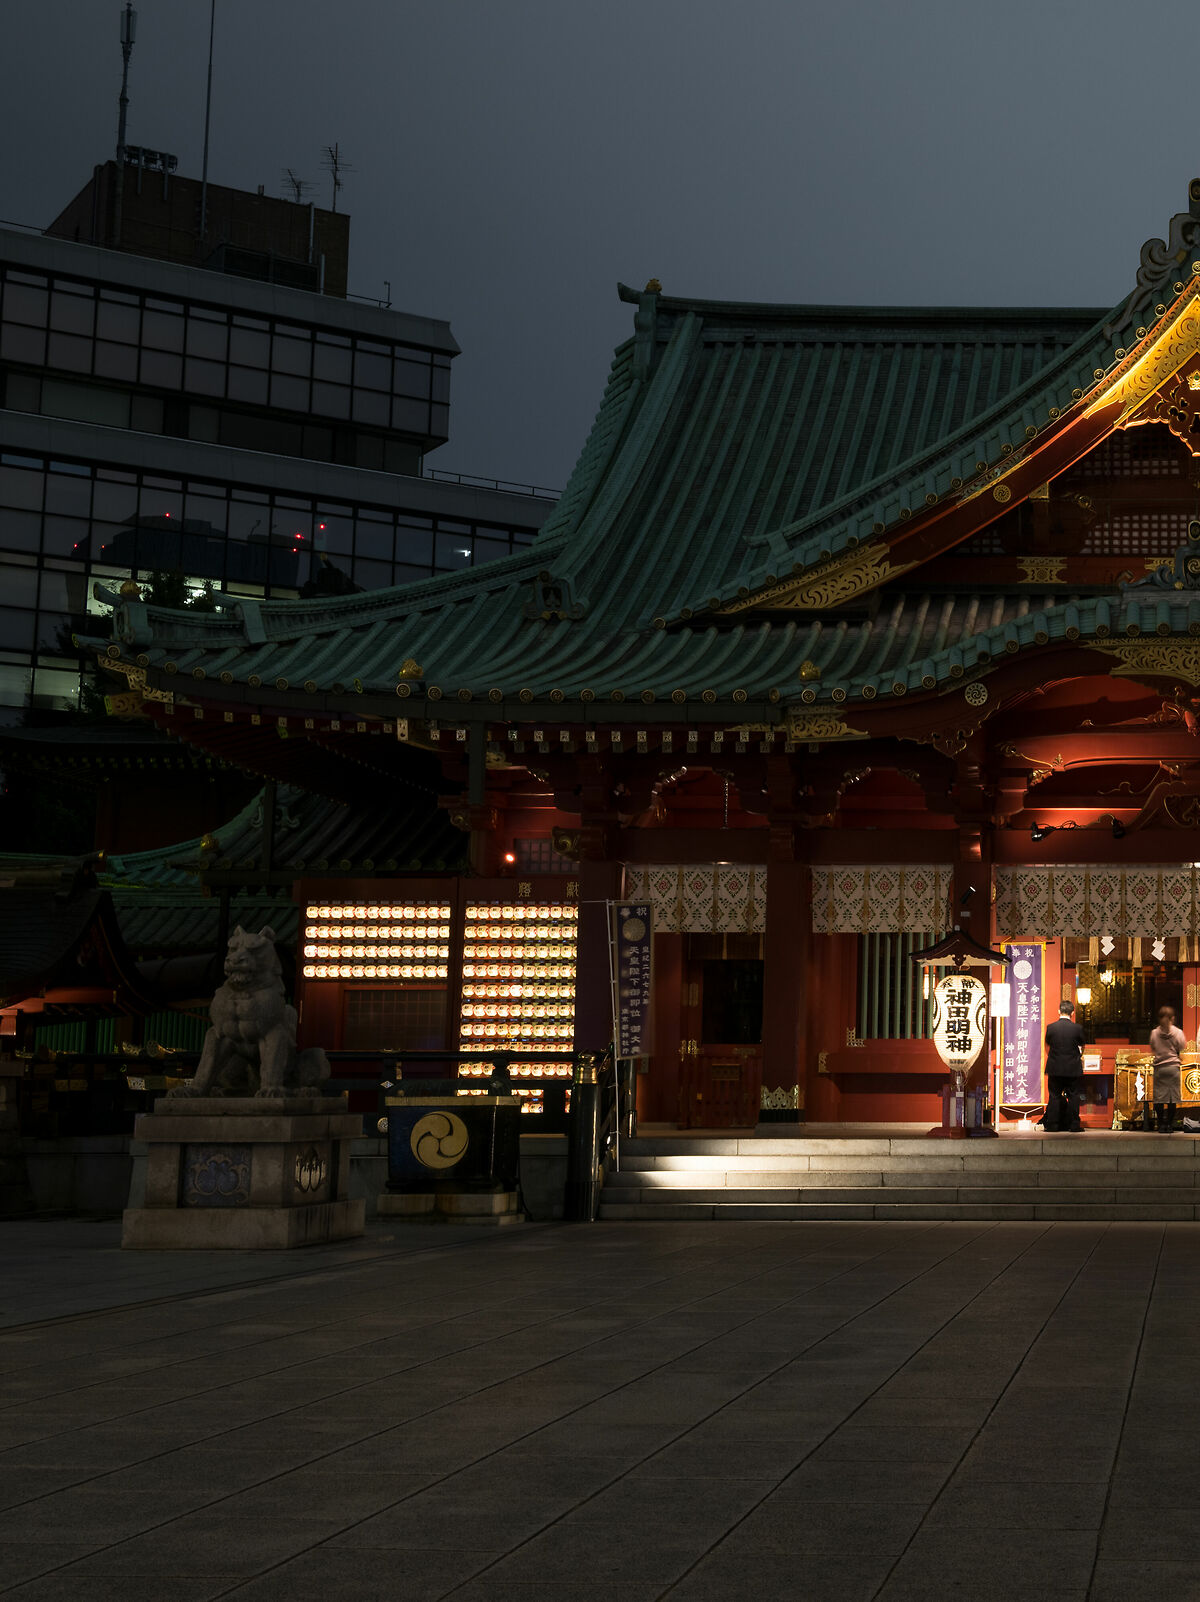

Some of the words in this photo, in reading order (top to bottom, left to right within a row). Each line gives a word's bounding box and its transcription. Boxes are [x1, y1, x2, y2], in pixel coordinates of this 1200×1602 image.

[944, 989, 973, 1054] 神田明神
[1030, 984, 1040, 1023] 令和元年
[1004, 1042, 1015, 1096] 神田神社
[1016, 982, 1029, 1099] 天皇陛下御即位御大典
